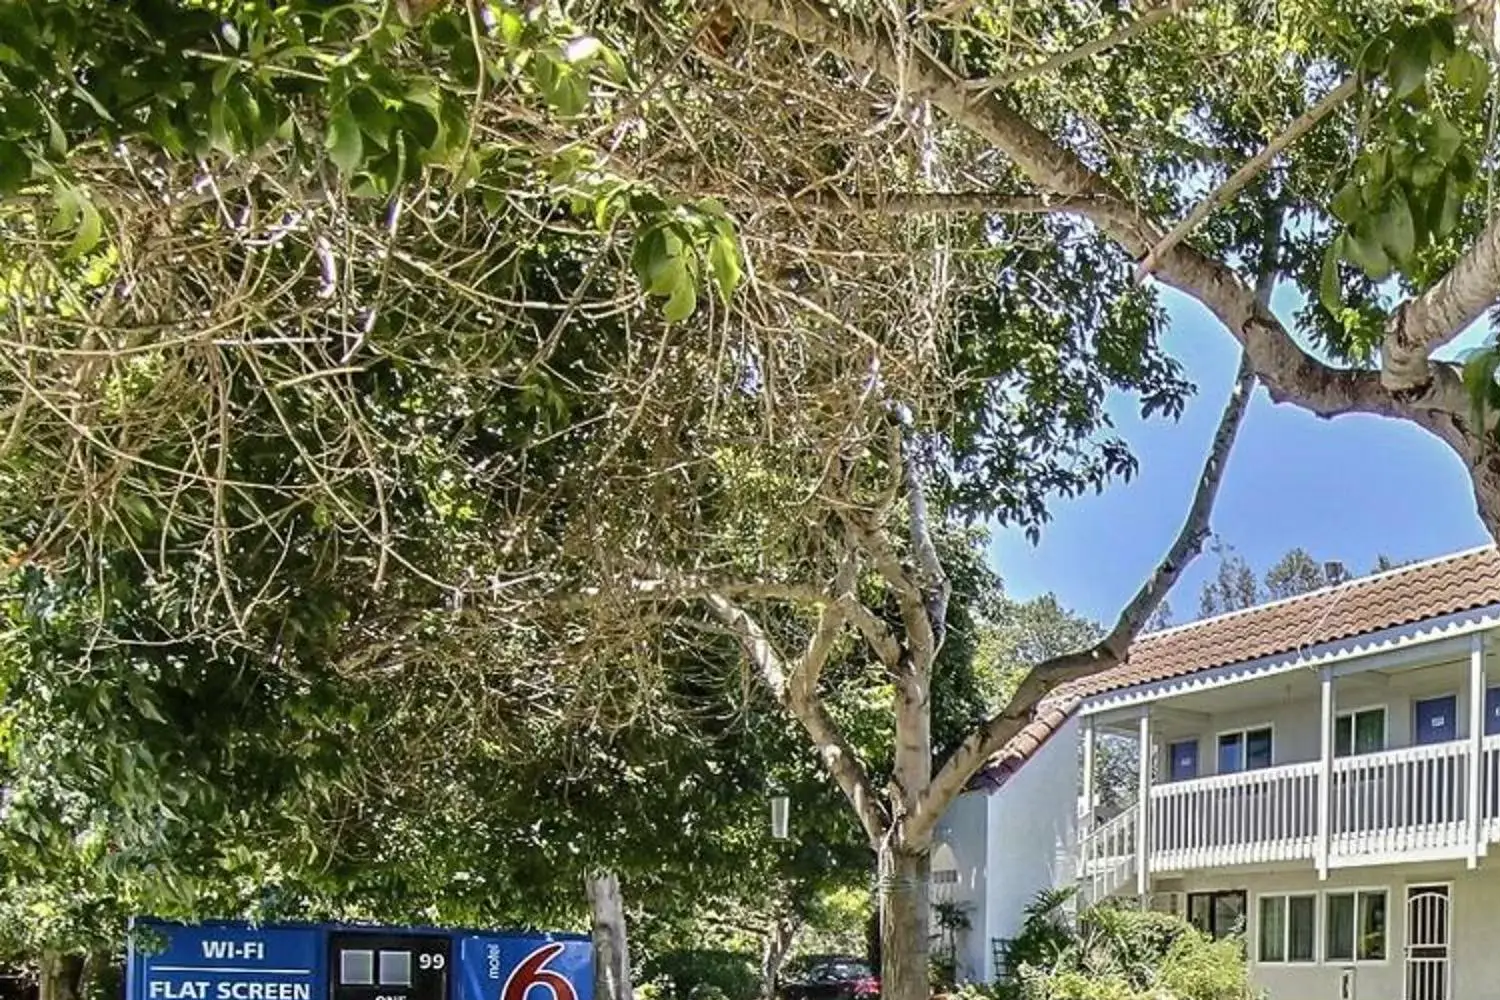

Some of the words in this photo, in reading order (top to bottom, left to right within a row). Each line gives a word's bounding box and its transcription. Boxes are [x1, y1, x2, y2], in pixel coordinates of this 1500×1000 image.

[202, 941, 264, 960] WI-FI
[419, 953, 445, 969] 99
[150, 981, 210, 999] FLAT
[217, 982, 311, 1000] SCREEN
